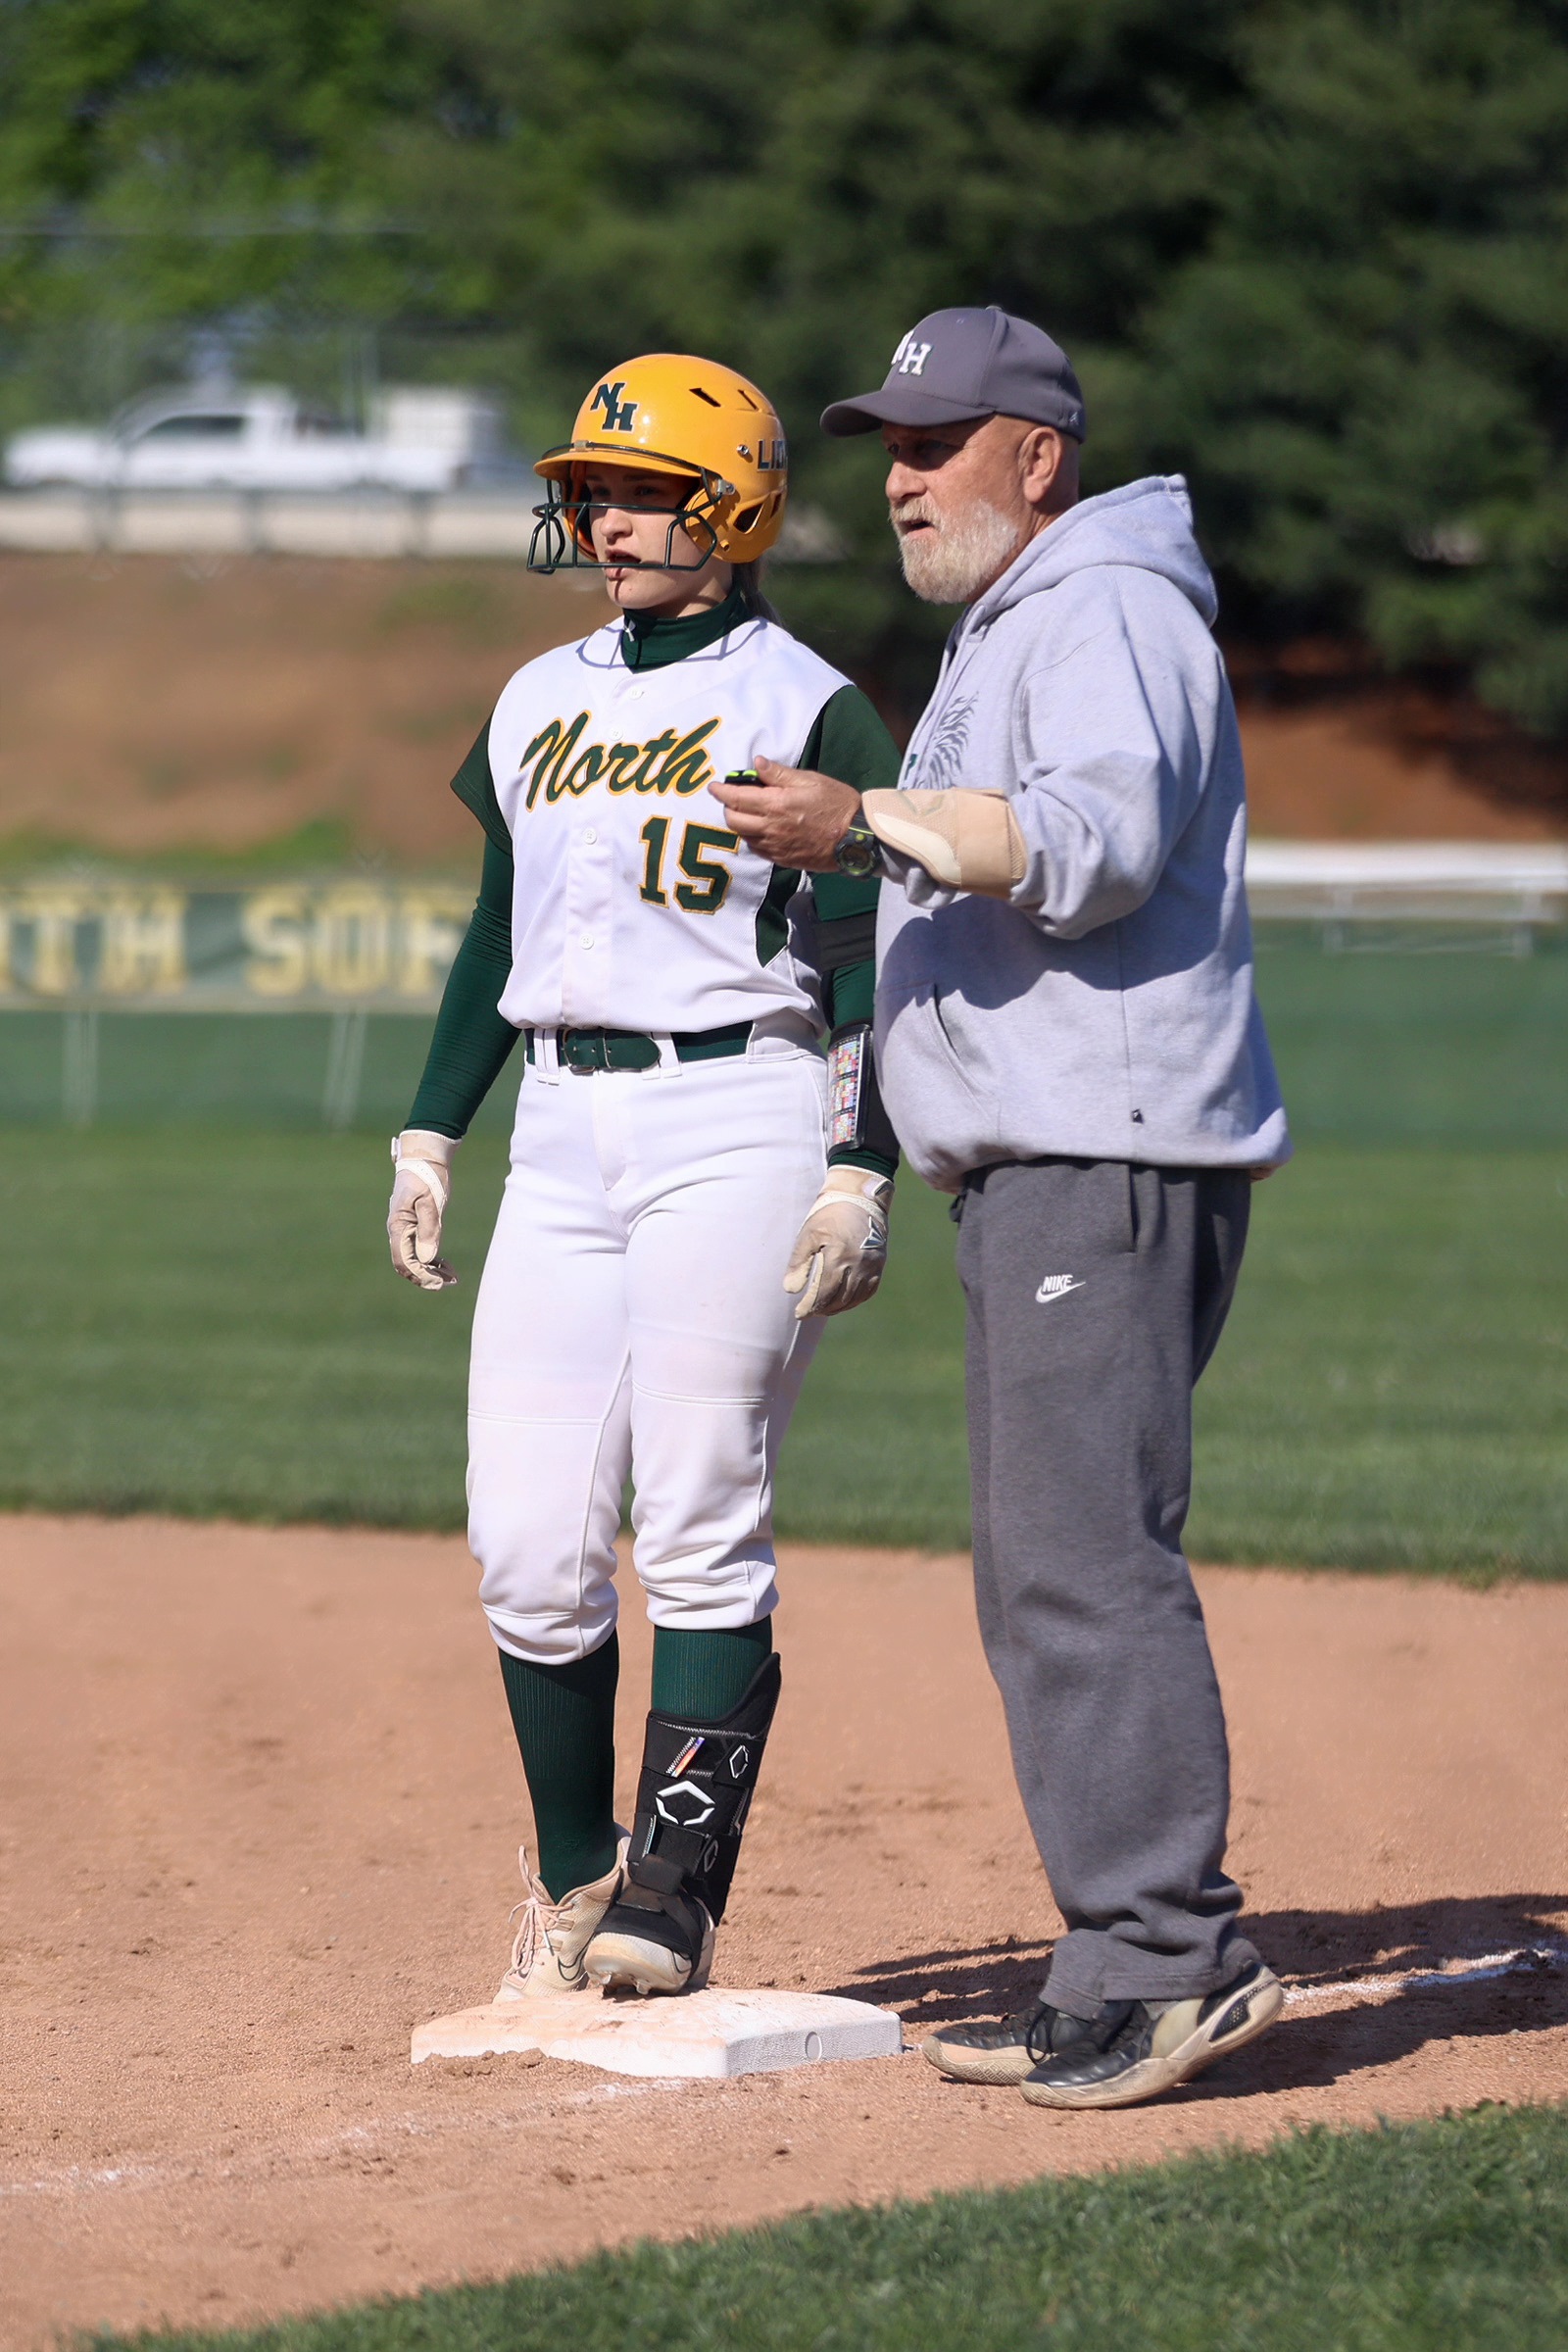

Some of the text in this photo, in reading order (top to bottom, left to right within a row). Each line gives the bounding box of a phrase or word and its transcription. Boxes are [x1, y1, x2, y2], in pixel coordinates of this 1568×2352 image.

[590, 381, 637, 432] NH
[518, 710, 721, 812] North
[638, 814, 741, 915] 15
[0, 885, 188, 994] TH
[1042, 1274, 1073, 1293] NIKE
